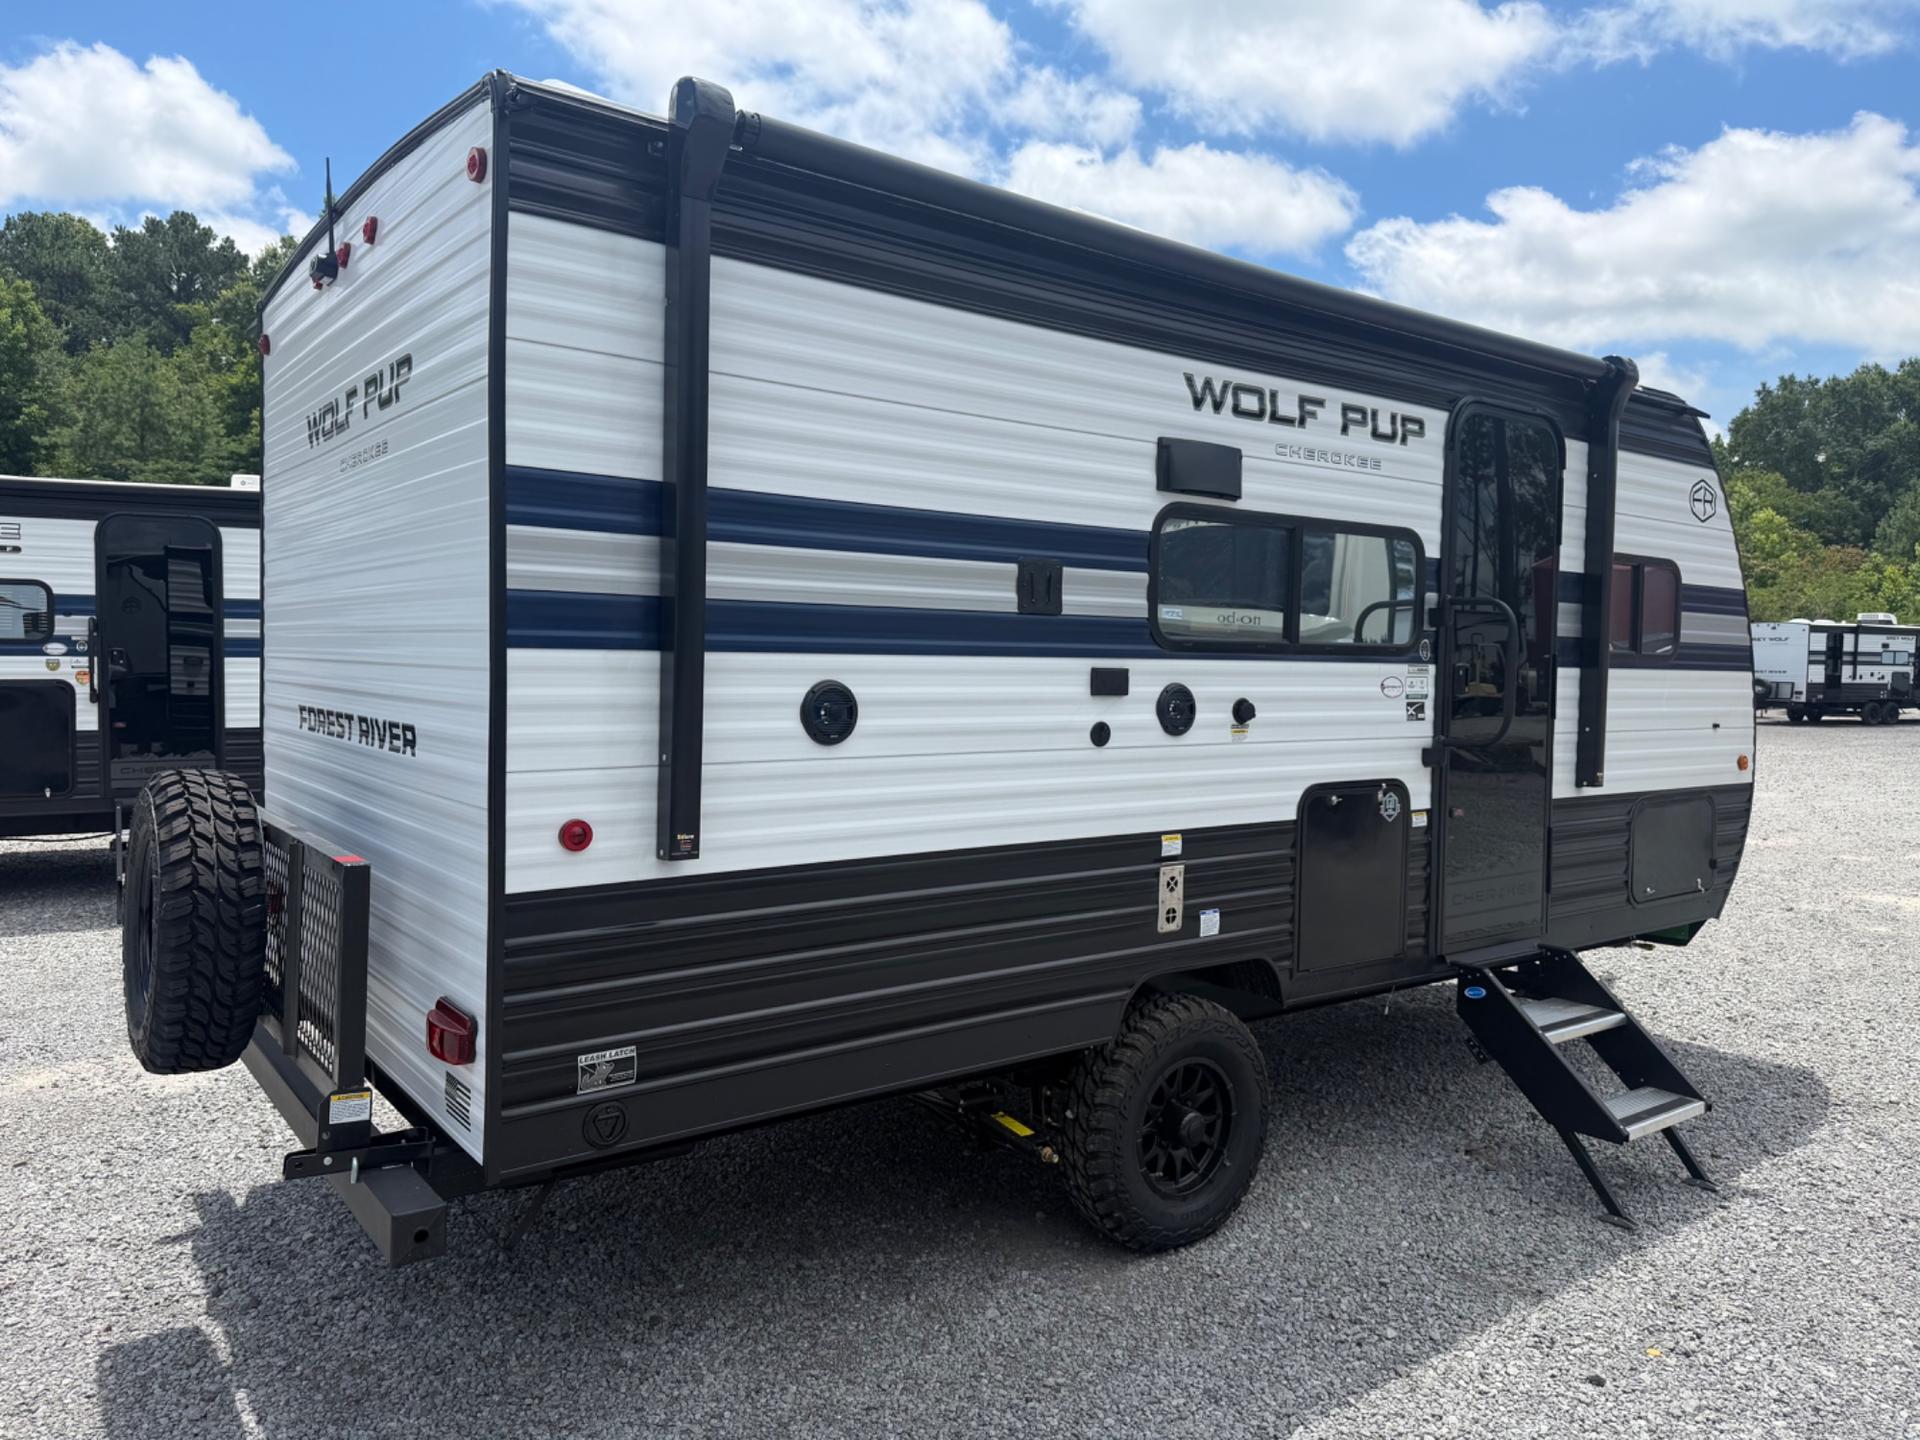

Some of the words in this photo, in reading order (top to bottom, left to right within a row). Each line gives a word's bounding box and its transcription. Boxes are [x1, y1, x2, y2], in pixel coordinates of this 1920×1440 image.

[305, 385, 358, 449] WOLF
[363, 353, 413, 420] PUP
[1183, 372, 1326, 429] WOLF
[1340, 402, 1425, 446] PUP
[339, 438, 389, 472] CHEROKEE
[1275, 443, 1382, 471] CHEROKEE
[298, 704, 354, 741] FOREST
[357, 715, 416, 757] RIVER
[580, 1053, 607, 1063] LEASH
[609, 1048, 635, 1058] LATCH
